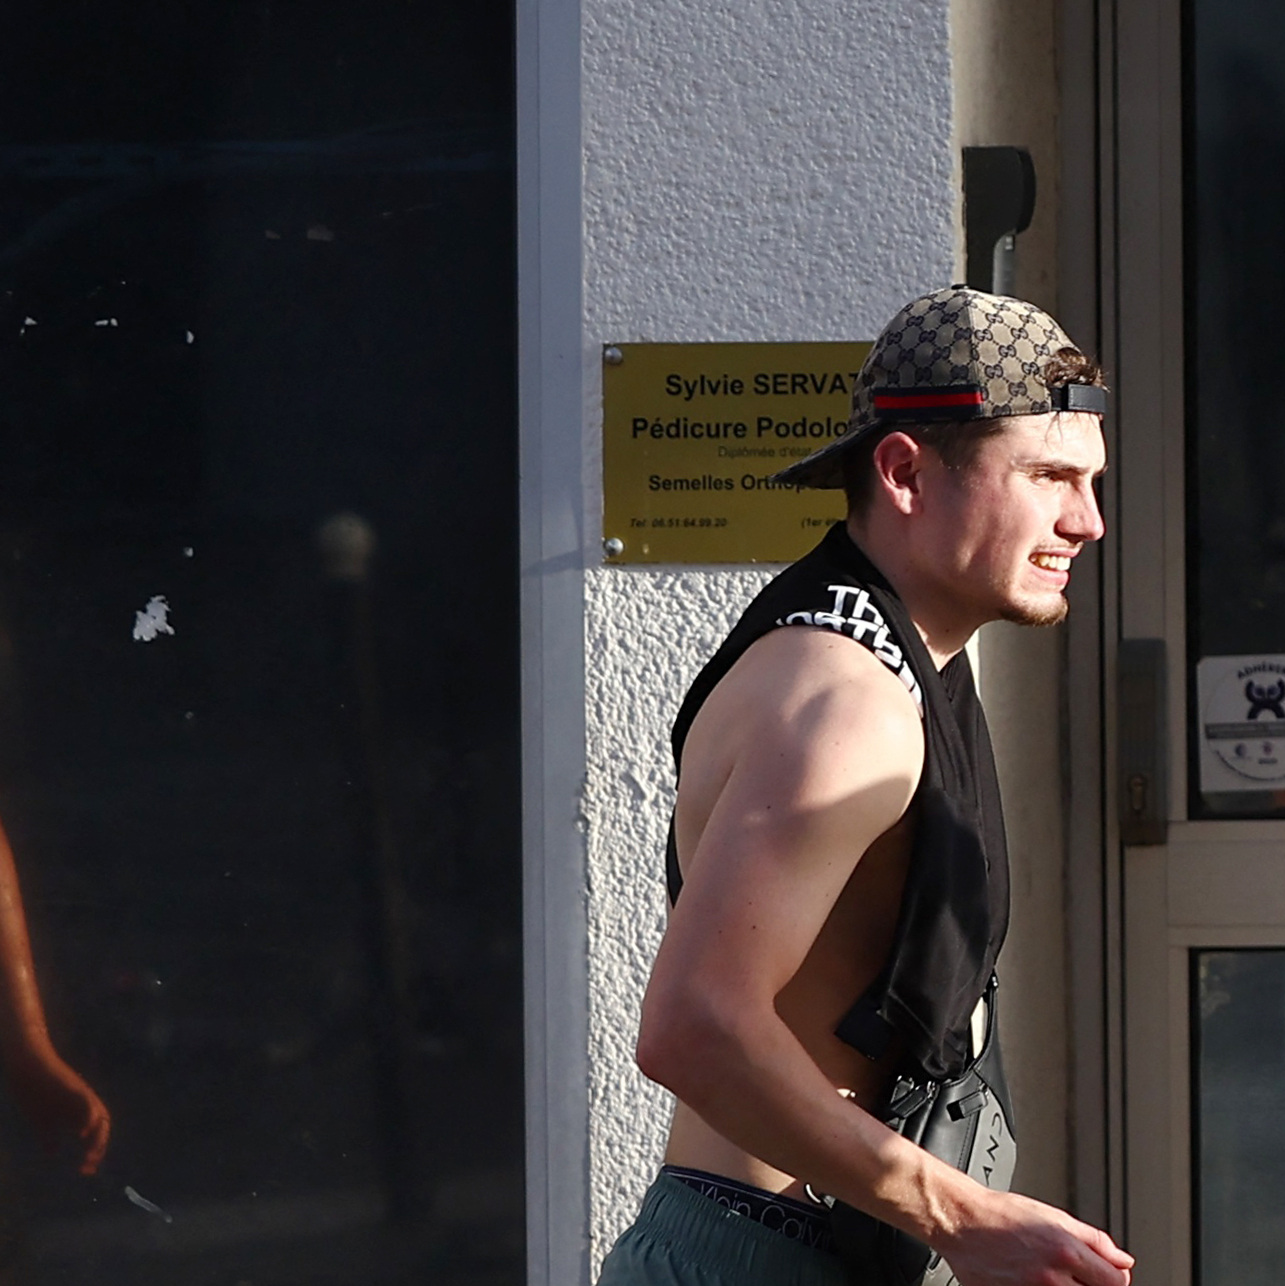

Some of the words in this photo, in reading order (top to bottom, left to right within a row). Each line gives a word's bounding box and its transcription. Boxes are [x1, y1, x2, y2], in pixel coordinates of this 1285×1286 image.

[665, 374, 744, 400] Sylvie
[632, 416, 747, 439] Pédicure
[757, 416, 852, 439] Podolo
[649, 474, 734, 491] Semelles
